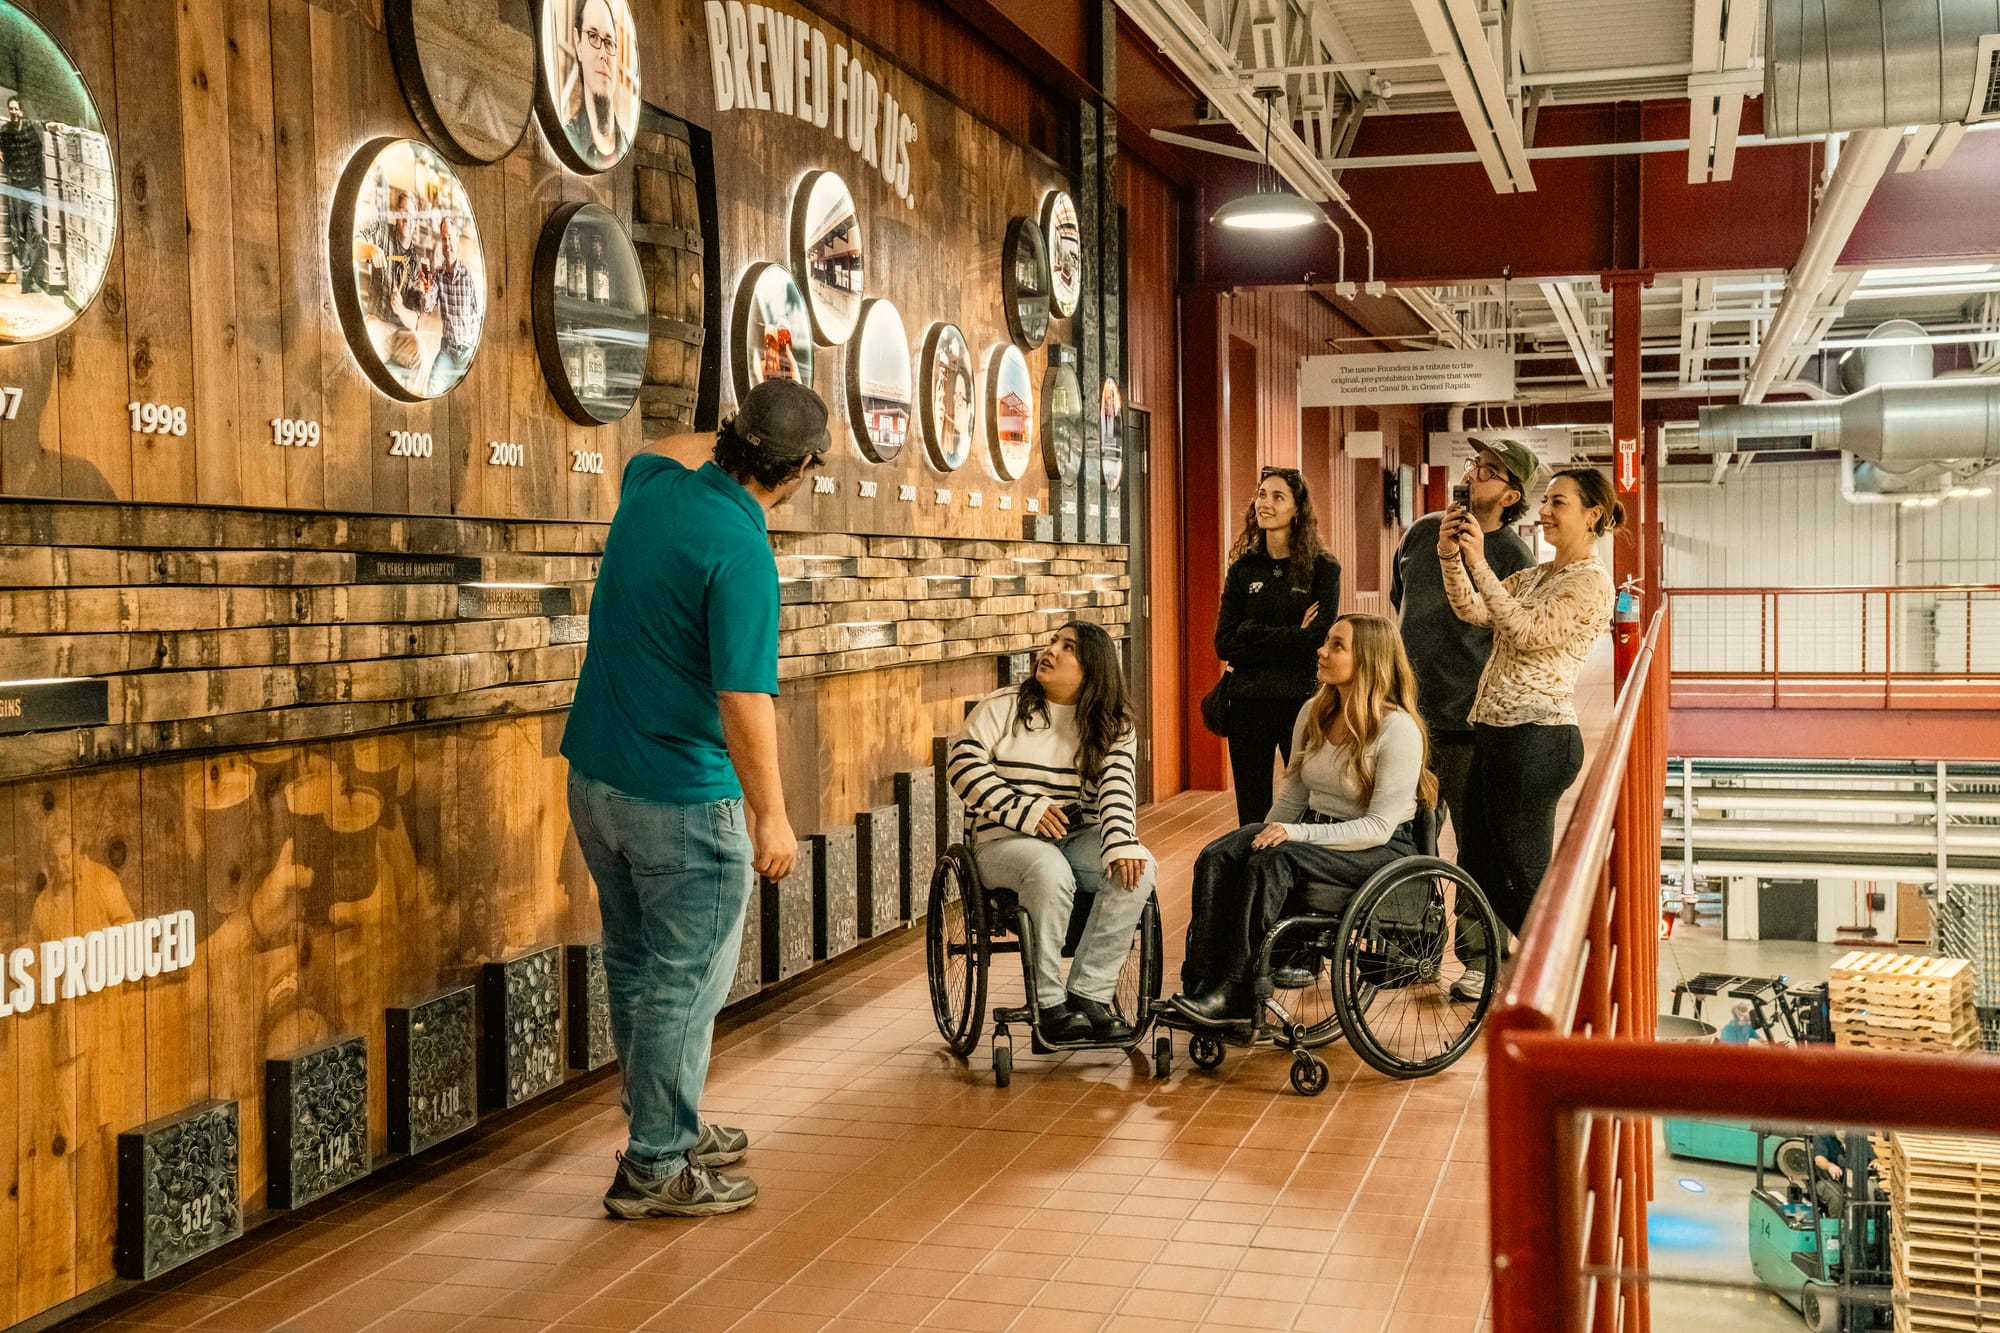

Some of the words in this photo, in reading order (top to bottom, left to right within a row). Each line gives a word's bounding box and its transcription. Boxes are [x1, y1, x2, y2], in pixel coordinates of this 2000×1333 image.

[704, 0, 829, 128] BREWED
[833, 43, 879, 169] FOR
[1340, 366, 1354, 374] The
[1377, 364, 1411, 373] Founders
[1461, 361, 1474, 369] the
[1416, 373, 1446, 381] brewers
[1340, 385, 1367, 393] located
[1379, 384, 1400, 392] Canal
[1420, 383, 1443, 391] Grand
[128, 401, 188, 437] 1998
[271, 418, 321, 448] 1999
[389, 430, 433, 458] 2000
[489, 441, 524, 467] 2001
[1621, 443, 1635, 451] FIRE
[572, 449, 604, 474] 2002
[813, 475, 835, 494] 2006
[859, 480, 878, 498] 2007
[899, 484, 917, 501] 2008
[377, 561, 386, 577] THE
[387, 561, 404, 577] VERGE
[405, 562, 412, 577] OF
[413, 562, 455, 577] BANKRUPTCY
[528, 601, 543, 614] BEER
[40, 909, 196, 1005] PRODUCED
[433, 1086, 460, 1122] 1,418
[181, 1194, 212, 1236] 532
